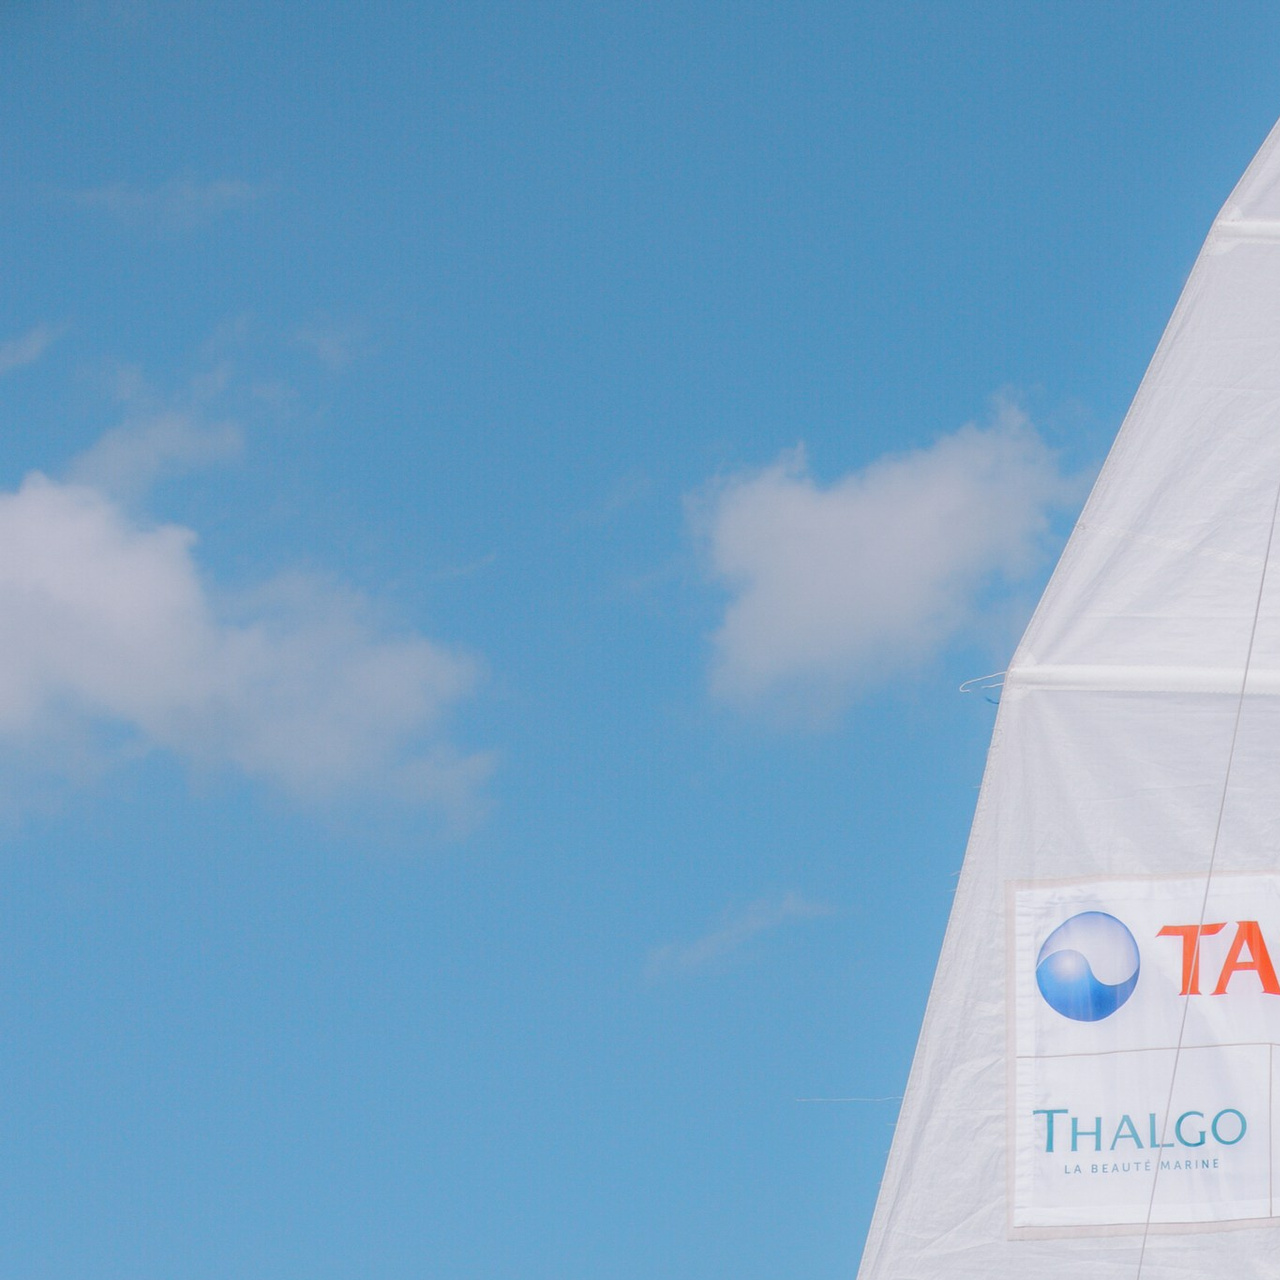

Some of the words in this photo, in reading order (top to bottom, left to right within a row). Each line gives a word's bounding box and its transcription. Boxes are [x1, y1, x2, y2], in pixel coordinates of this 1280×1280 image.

[1064, 1164, 1082, 1175] LA
[1091, 1159, 1151, 1174] BEAUTÉ
[1160, 1158, 1219, 1171] MARINE
